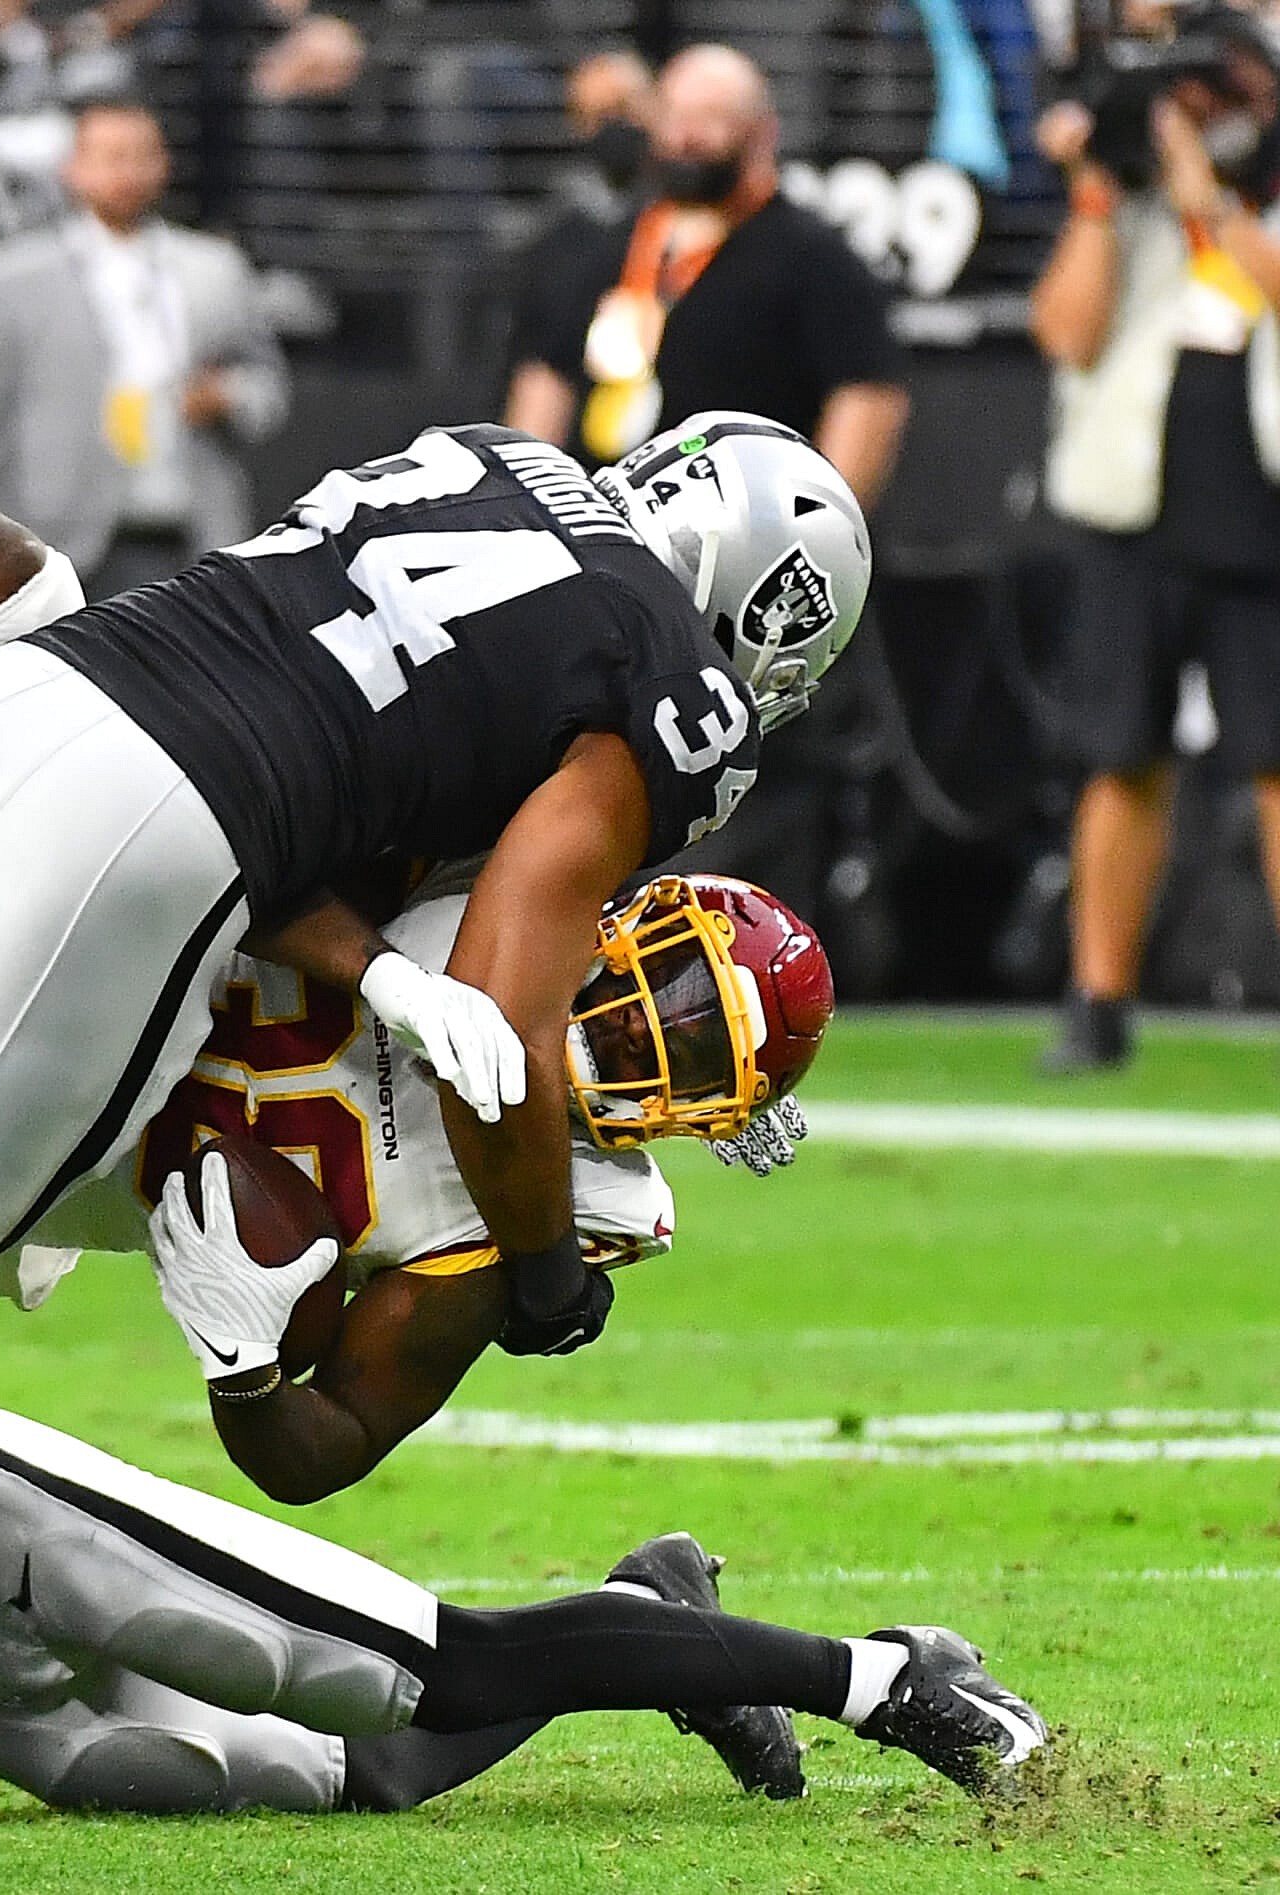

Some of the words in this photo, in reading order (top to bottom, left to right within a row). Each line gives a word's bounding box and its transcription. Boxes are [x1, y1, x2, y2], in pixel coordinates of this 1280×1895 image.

[793, 556, 832, 620] RAIDERS
[653, 665, 758, 848] 34
[373, 1016, 400, 1161] SHINGTON
